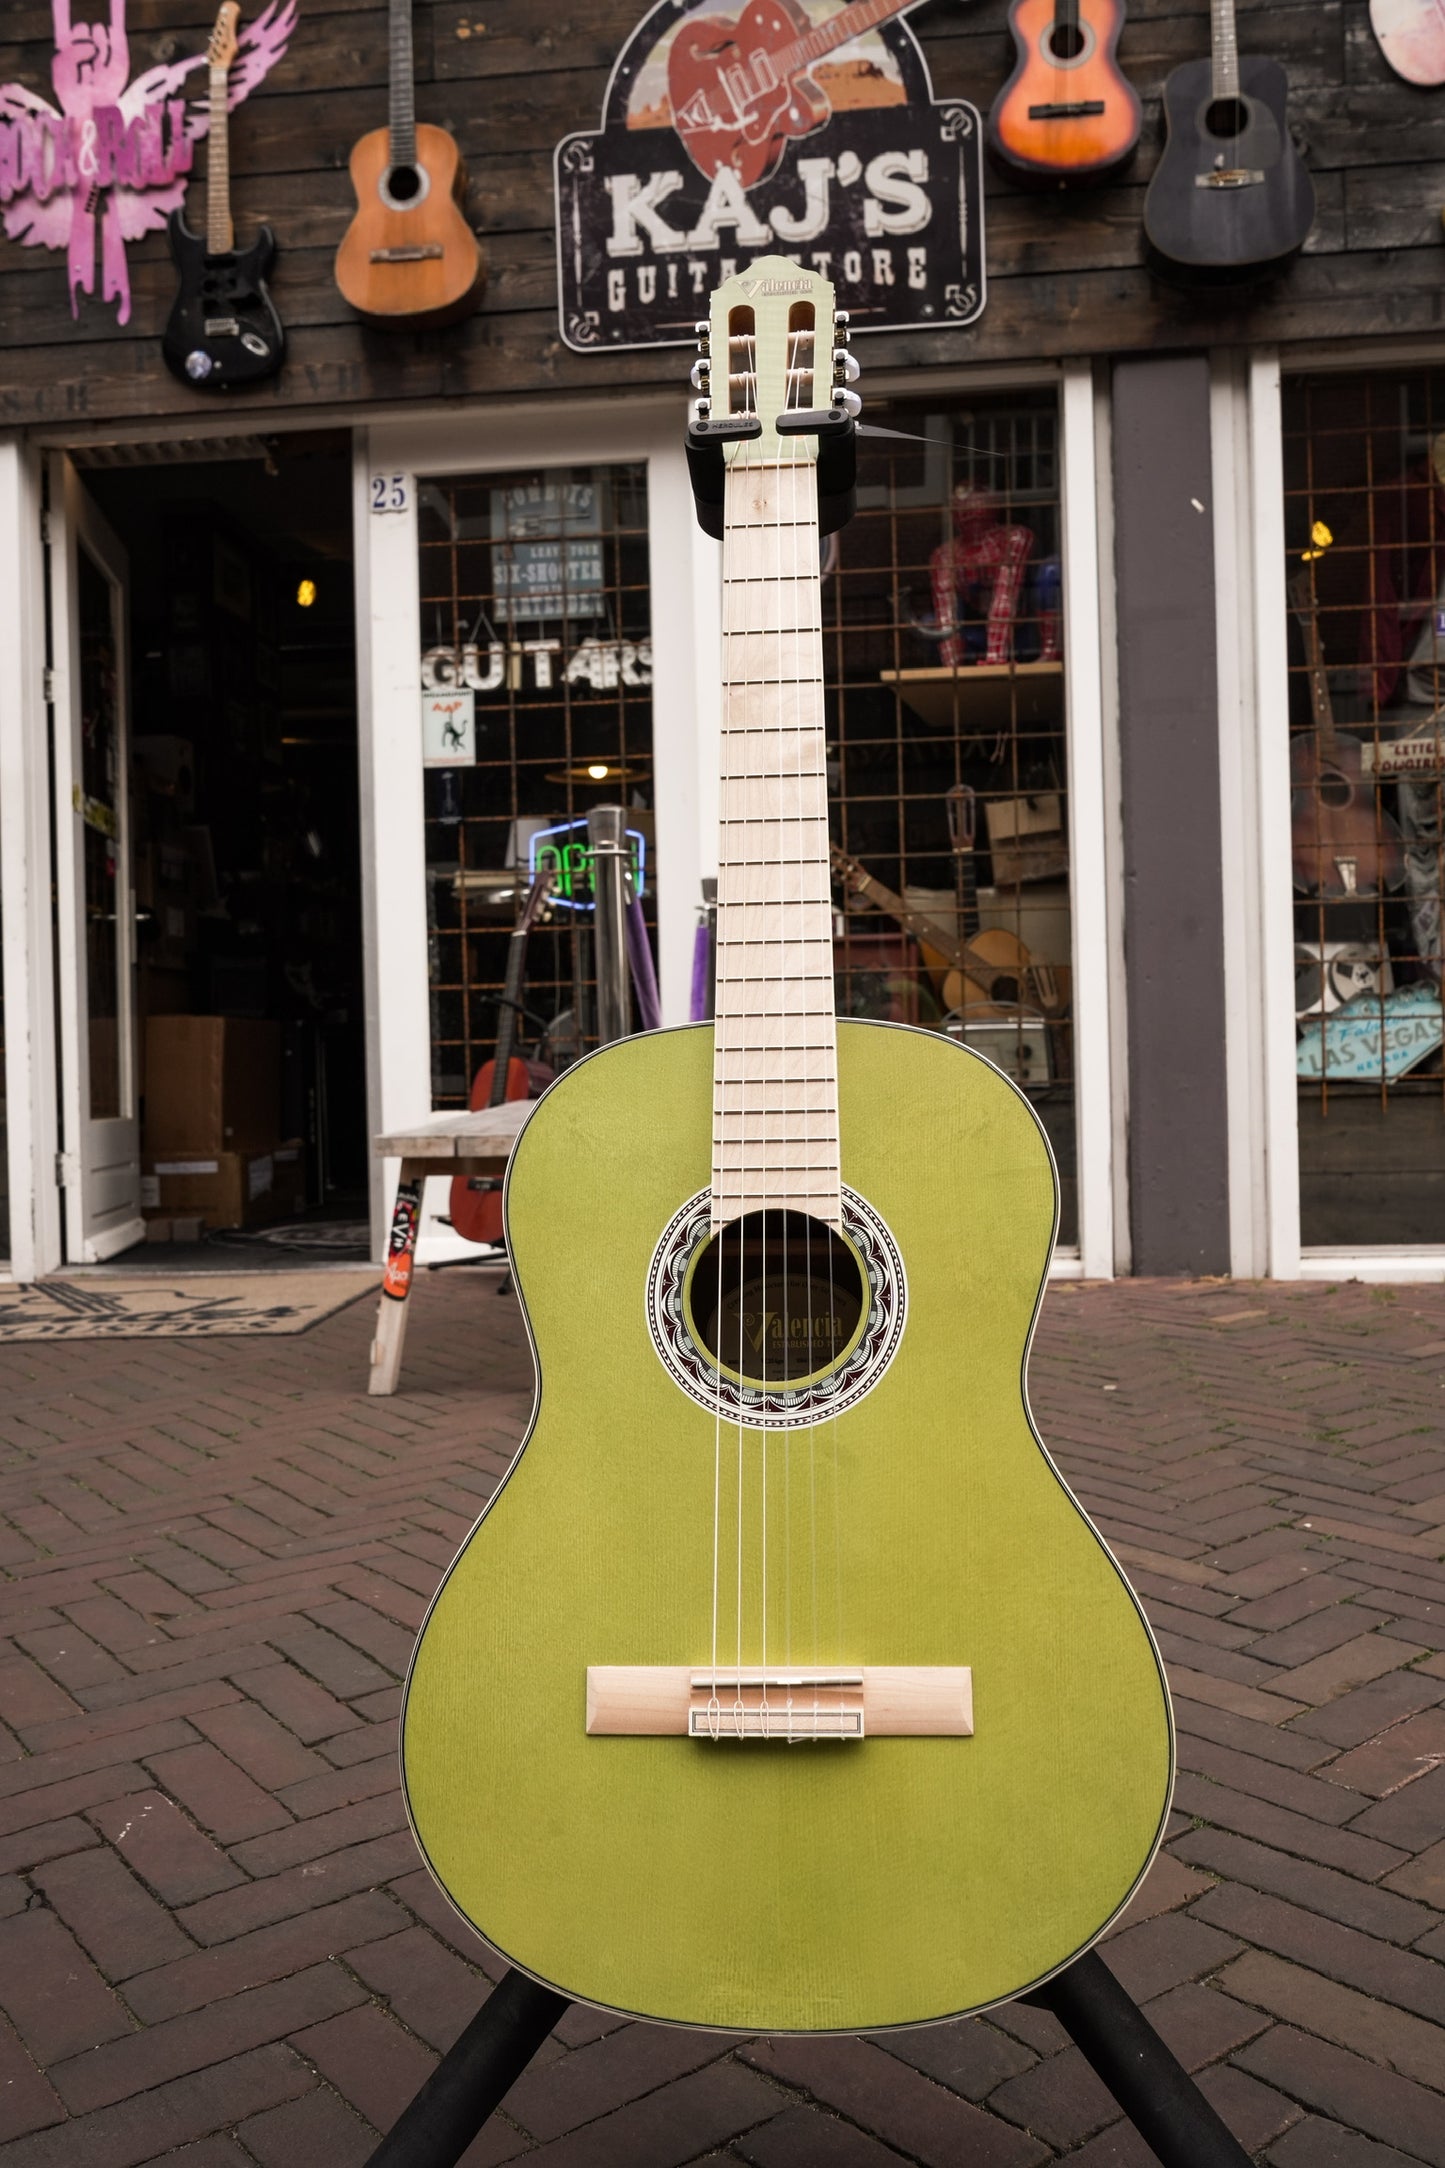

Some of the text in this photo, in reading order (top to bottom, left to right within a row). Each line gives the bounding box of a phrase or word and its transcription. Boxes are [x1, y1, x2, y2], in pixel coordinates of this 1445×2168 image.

[0, 110, 78, 201] OCK
[78, 119, 99, 176] &
[604, 150, 933, 258] KAJ'S
[736, 278, 814, 299] Valencia
[712, 421, 754, 430] HERCULES
[373, 477, 405, 508] 25
[529, 546, 566, 558] LEAV
[1308, 1016, 1444, 1073] LAS VEGAS
[731, 1311, 844, 1352] Valencia
